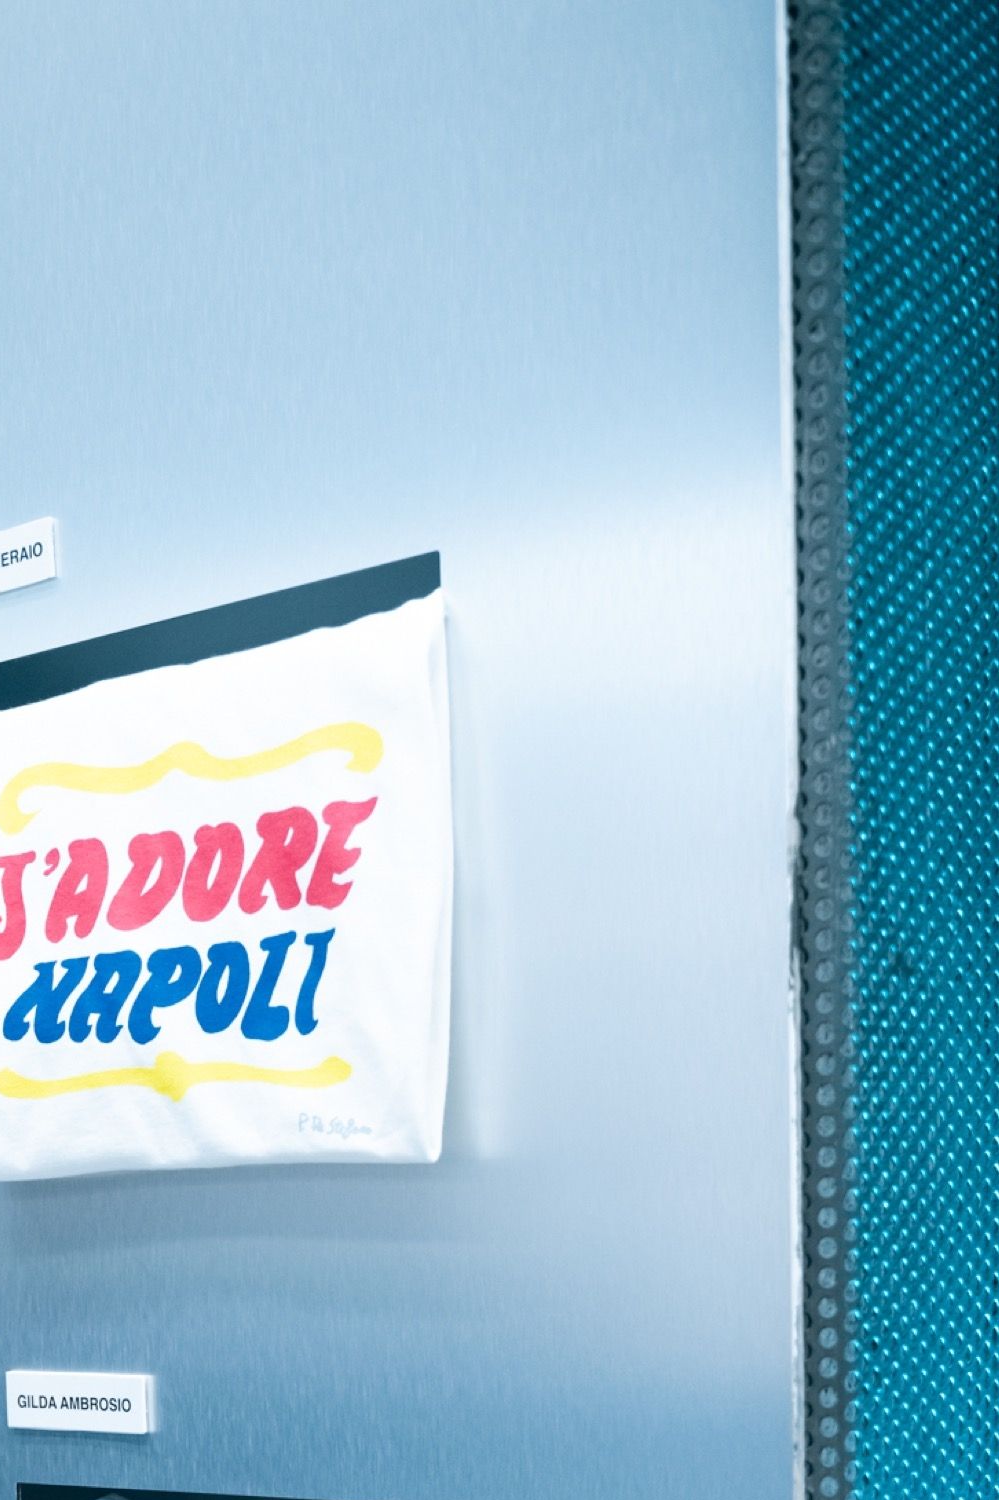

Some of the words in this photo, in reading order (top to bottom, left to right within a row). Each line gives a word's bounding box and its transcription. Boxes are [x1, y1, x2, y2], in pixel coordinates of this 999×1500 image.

[2, 928, 336, 1046] NAPOLI
[17, 1394, 57, 1409] GILDA
[60, 1396, 132, 1413] AMBROSIO
